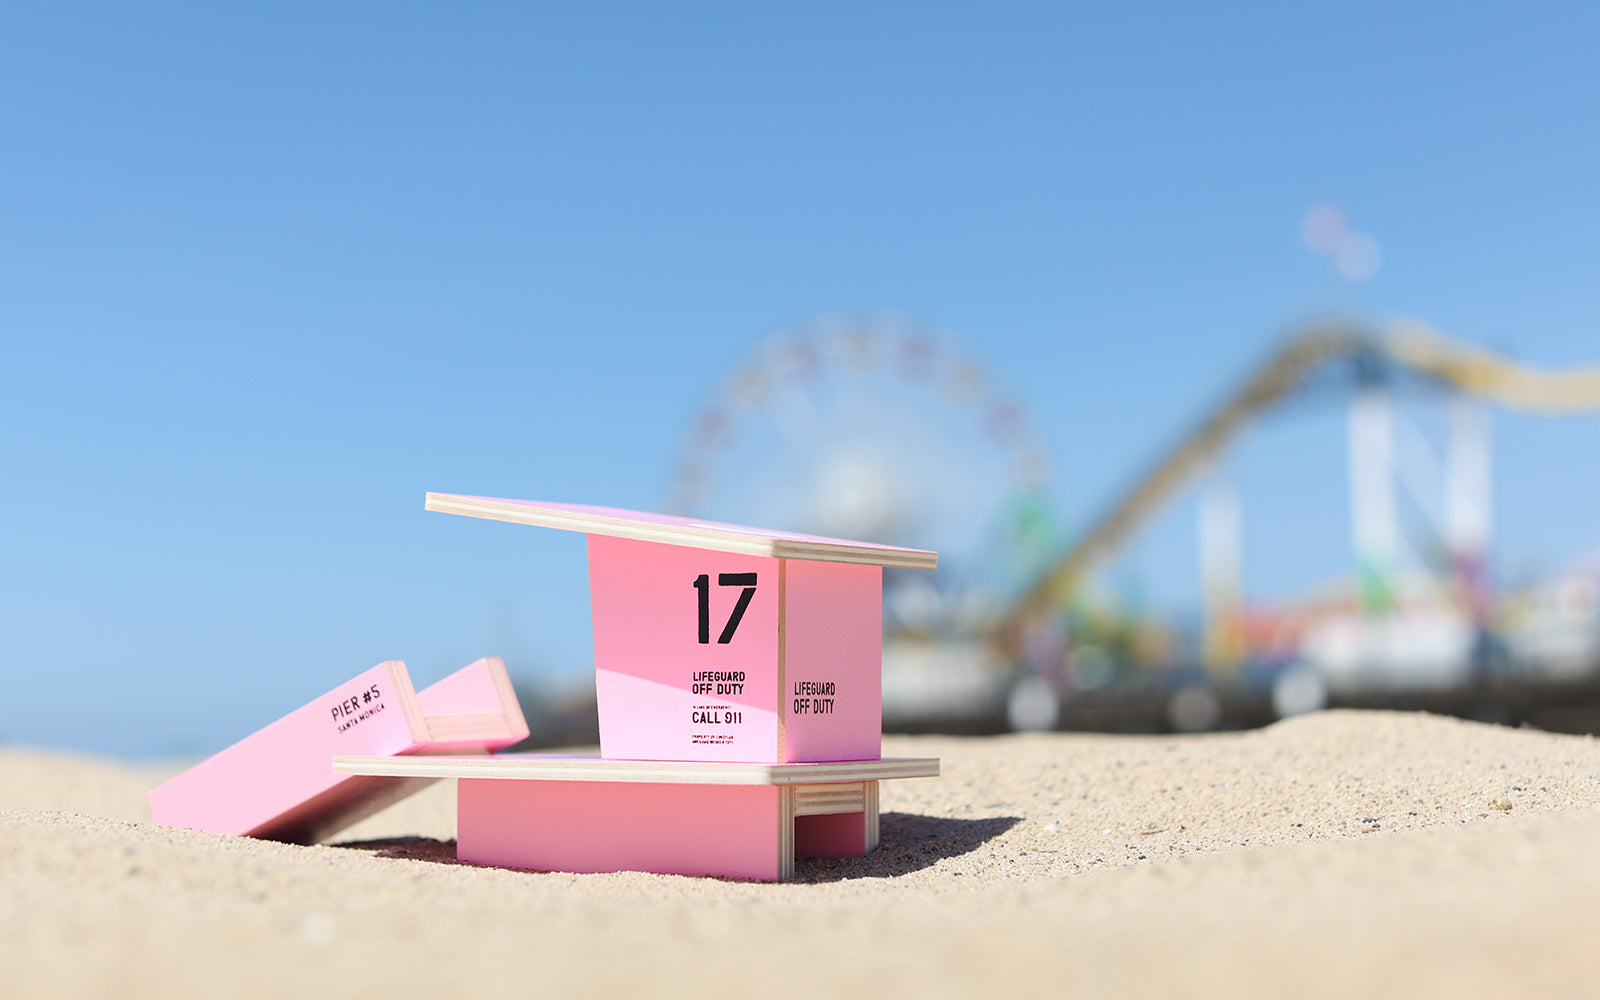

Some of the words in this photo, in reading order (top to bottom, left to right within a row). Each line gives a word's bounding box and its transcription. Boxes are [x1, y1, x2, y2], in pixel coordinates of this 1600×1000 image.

[693, 573, 757, 644] 17
[693, 671, 746, 682] LIFEGUARD
[692, 683, 712, 695] OFF
[717, 683, 744, 695] DUTY
[794, 681, 836, 696] LIFEGUARD
[331, 696, 360, 722] PIER
[363, 684, 380, 703] #5
[794, 698, 810, 714] OFF
[813, 699, 835, 714] DUTY
[338, 718, 358, 734] SANTA
[359, 703, 385, 720] MONICA
[692, 711, 721, 724] CALL
[725, 711, 742, 724] 911
